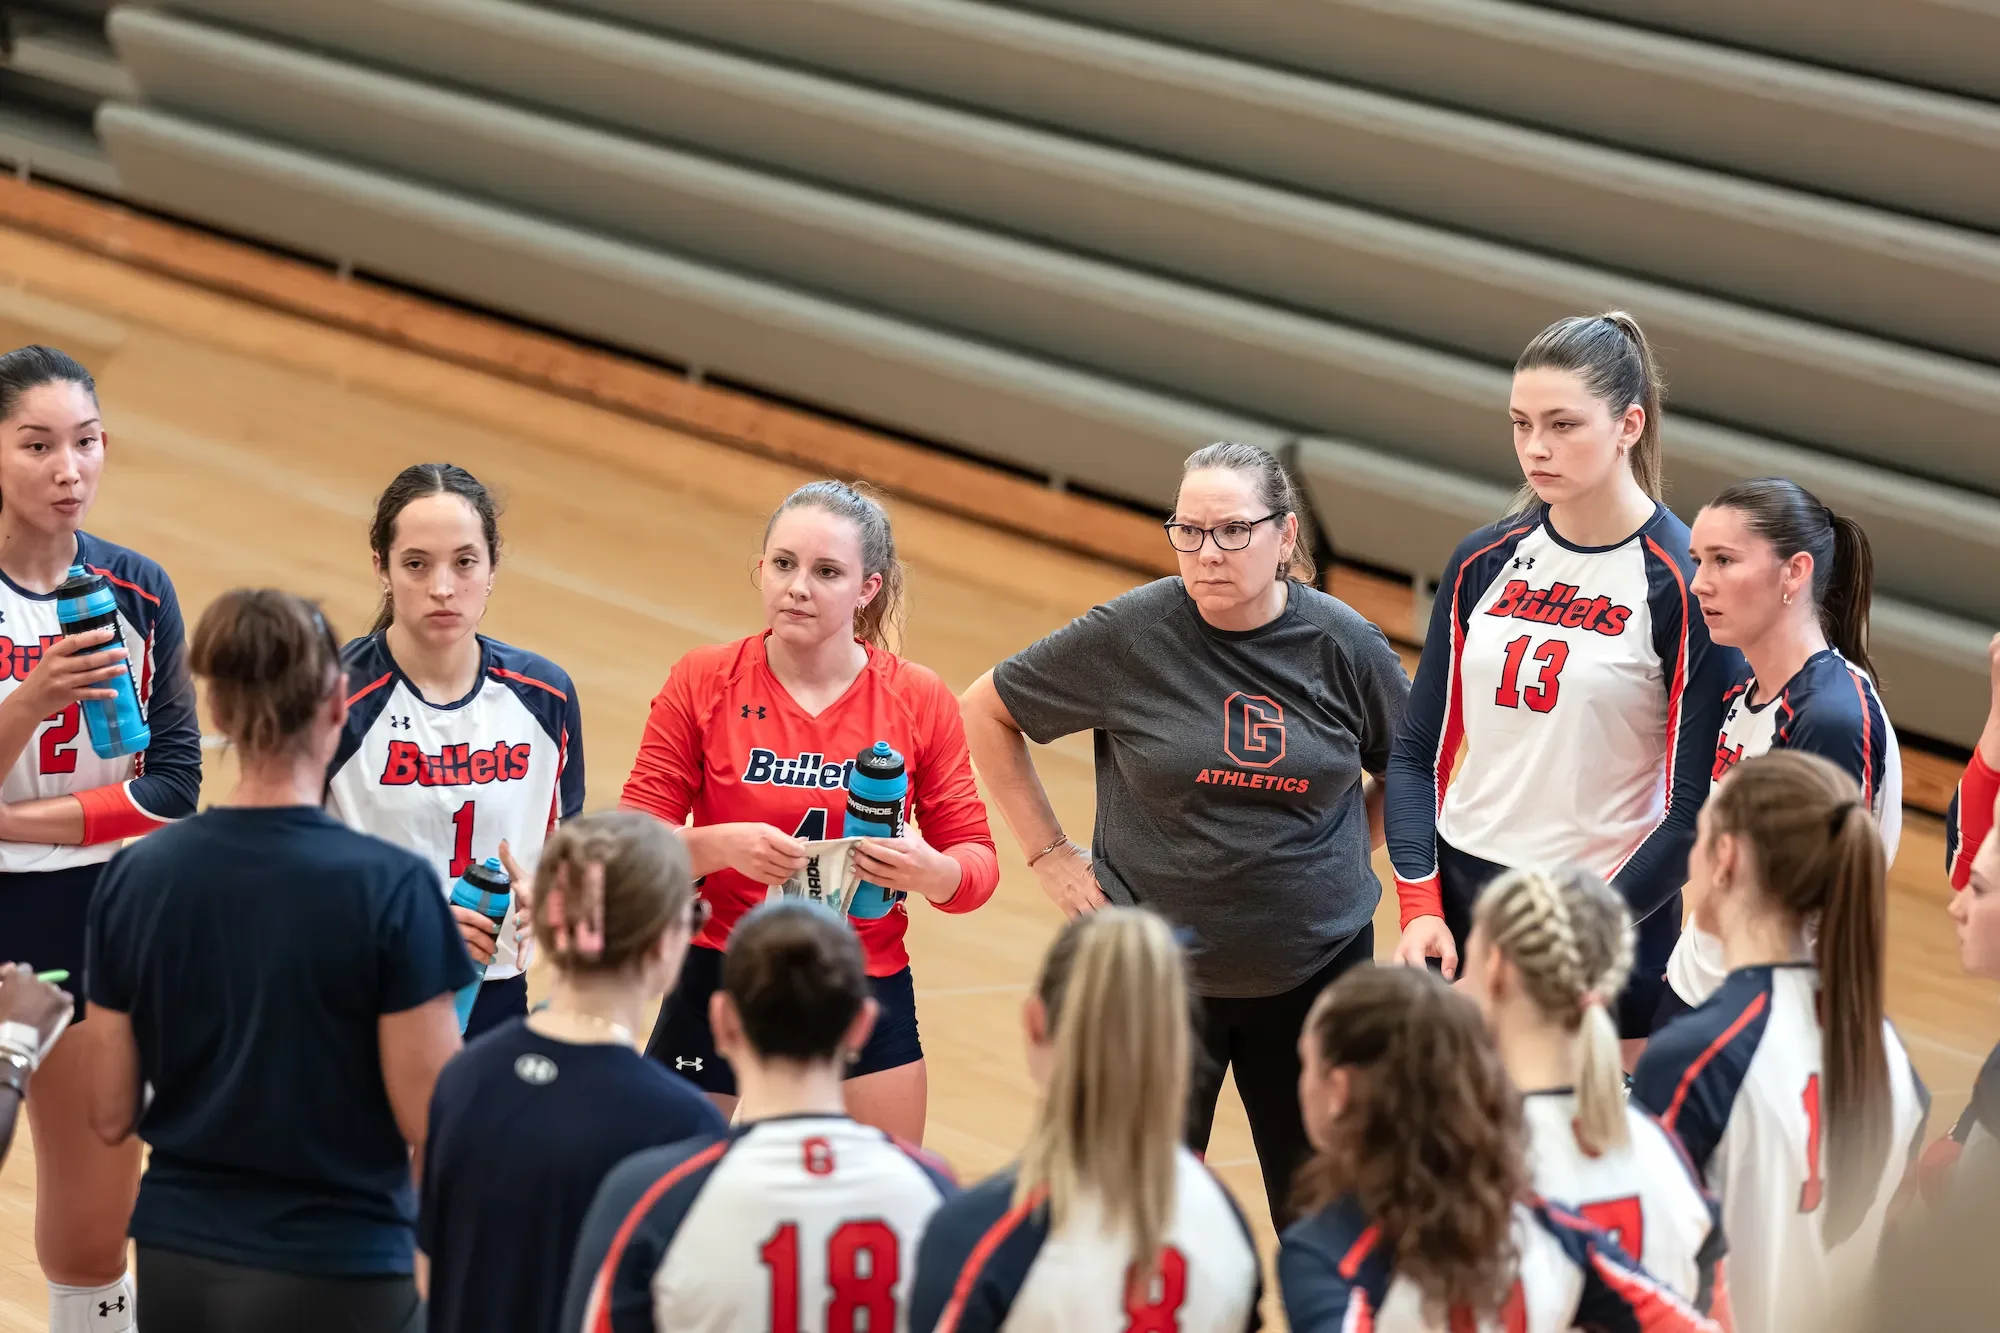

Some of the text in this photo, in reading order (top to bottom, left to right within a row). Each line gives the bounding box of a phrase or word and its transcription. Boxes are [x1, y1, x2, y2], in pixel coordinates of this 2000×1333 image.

[1484, 579, 1633, 637] Bullets
[1494, 634, 1570, 714] 13
[39, 700, 81, 775] 2
[379, 740, 532, 787] Bullets
[1223, 690, 1287, 769] G
[741, 748, 855, 790] Bullet
[1195, 768, 1310, 793] ATHLETICS
[449, 800, 477, 878] 1
[759, 1217, 902, 1333] 18
